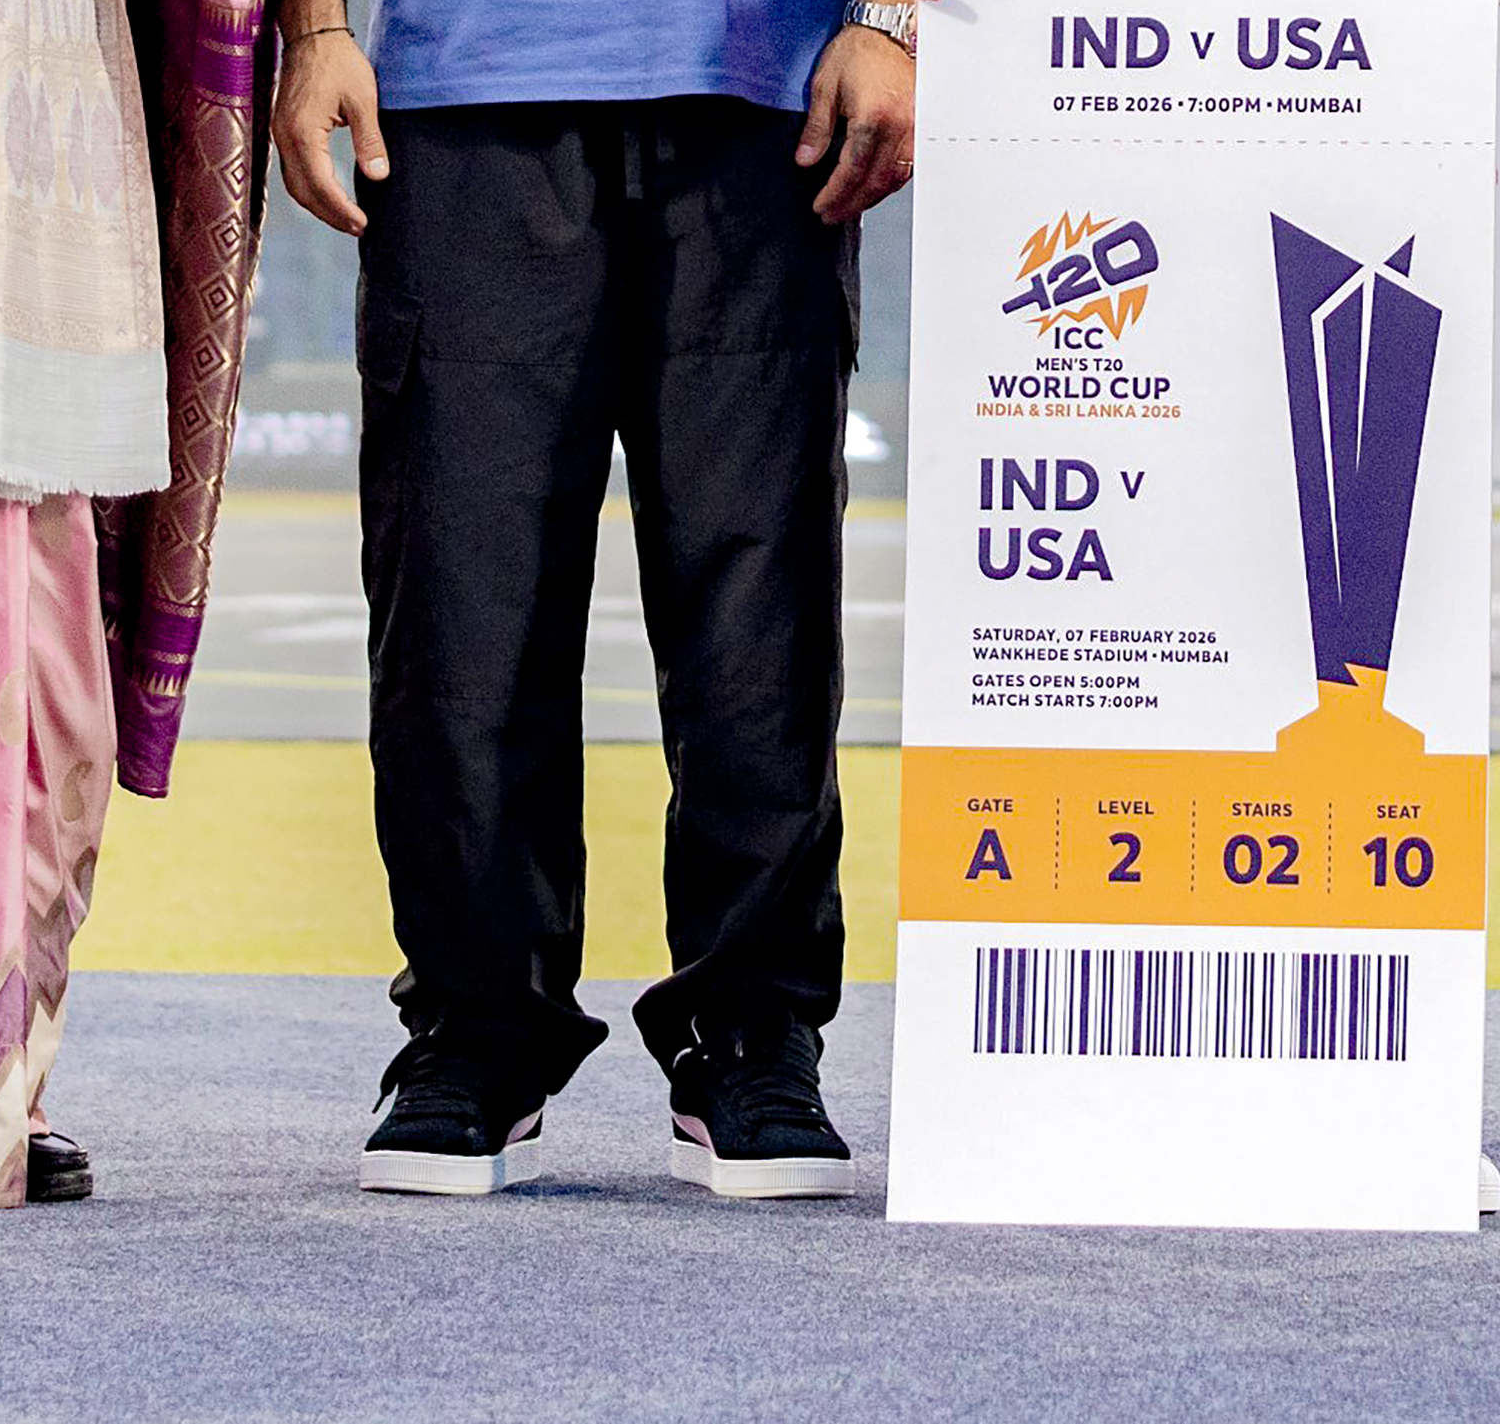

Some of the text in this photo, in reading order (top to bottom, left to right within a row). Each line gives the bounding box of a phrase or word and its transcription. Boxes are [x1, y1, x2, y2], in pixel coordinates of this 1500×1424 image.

[1050, 16, 1170, 69] IND
[1237, 17, 1373, 71] USA
[1053, 96, 1362, 113] 07 FEB 2026 7:00PM MUMBAI
[1002, 220, 1160, 315] T20
[1054, 326, 1104, 350] ICC
[1037, 357, 1123, 372] MEN'S T20
[989, 375, 1171, 400] WORLD CUP
[976, 402, 1181, 419] INDIA & SRI LANKA 2026
[979, 457, 1100, 512] IND
[978, 527, 1114, 582] USA
[972, 627, 1217, 645] SATURDAY, 07 FEBRUARY 2026
[972, 647, 1229, 664] WANKHEDE STADIUM MUMBAI
[972, 674, 1140, 689] GATES OPEN 5:00PM
[971, 693, 1158, 709] MATCH STARTS 7:00PM
[967, 798, 1014, 813] GATE
[1098, 800, 1155, 815] LEVEL
[1231, 802, 1293, 818] STAIRS
[1376, 804, 1421, 819] SEAT
[965, 828, 1013, 881] A
[1108, 832, 1142, 883] 2
[1223, 834, 1300, 886] 02
[1363, 837, 1434, 888] 10
